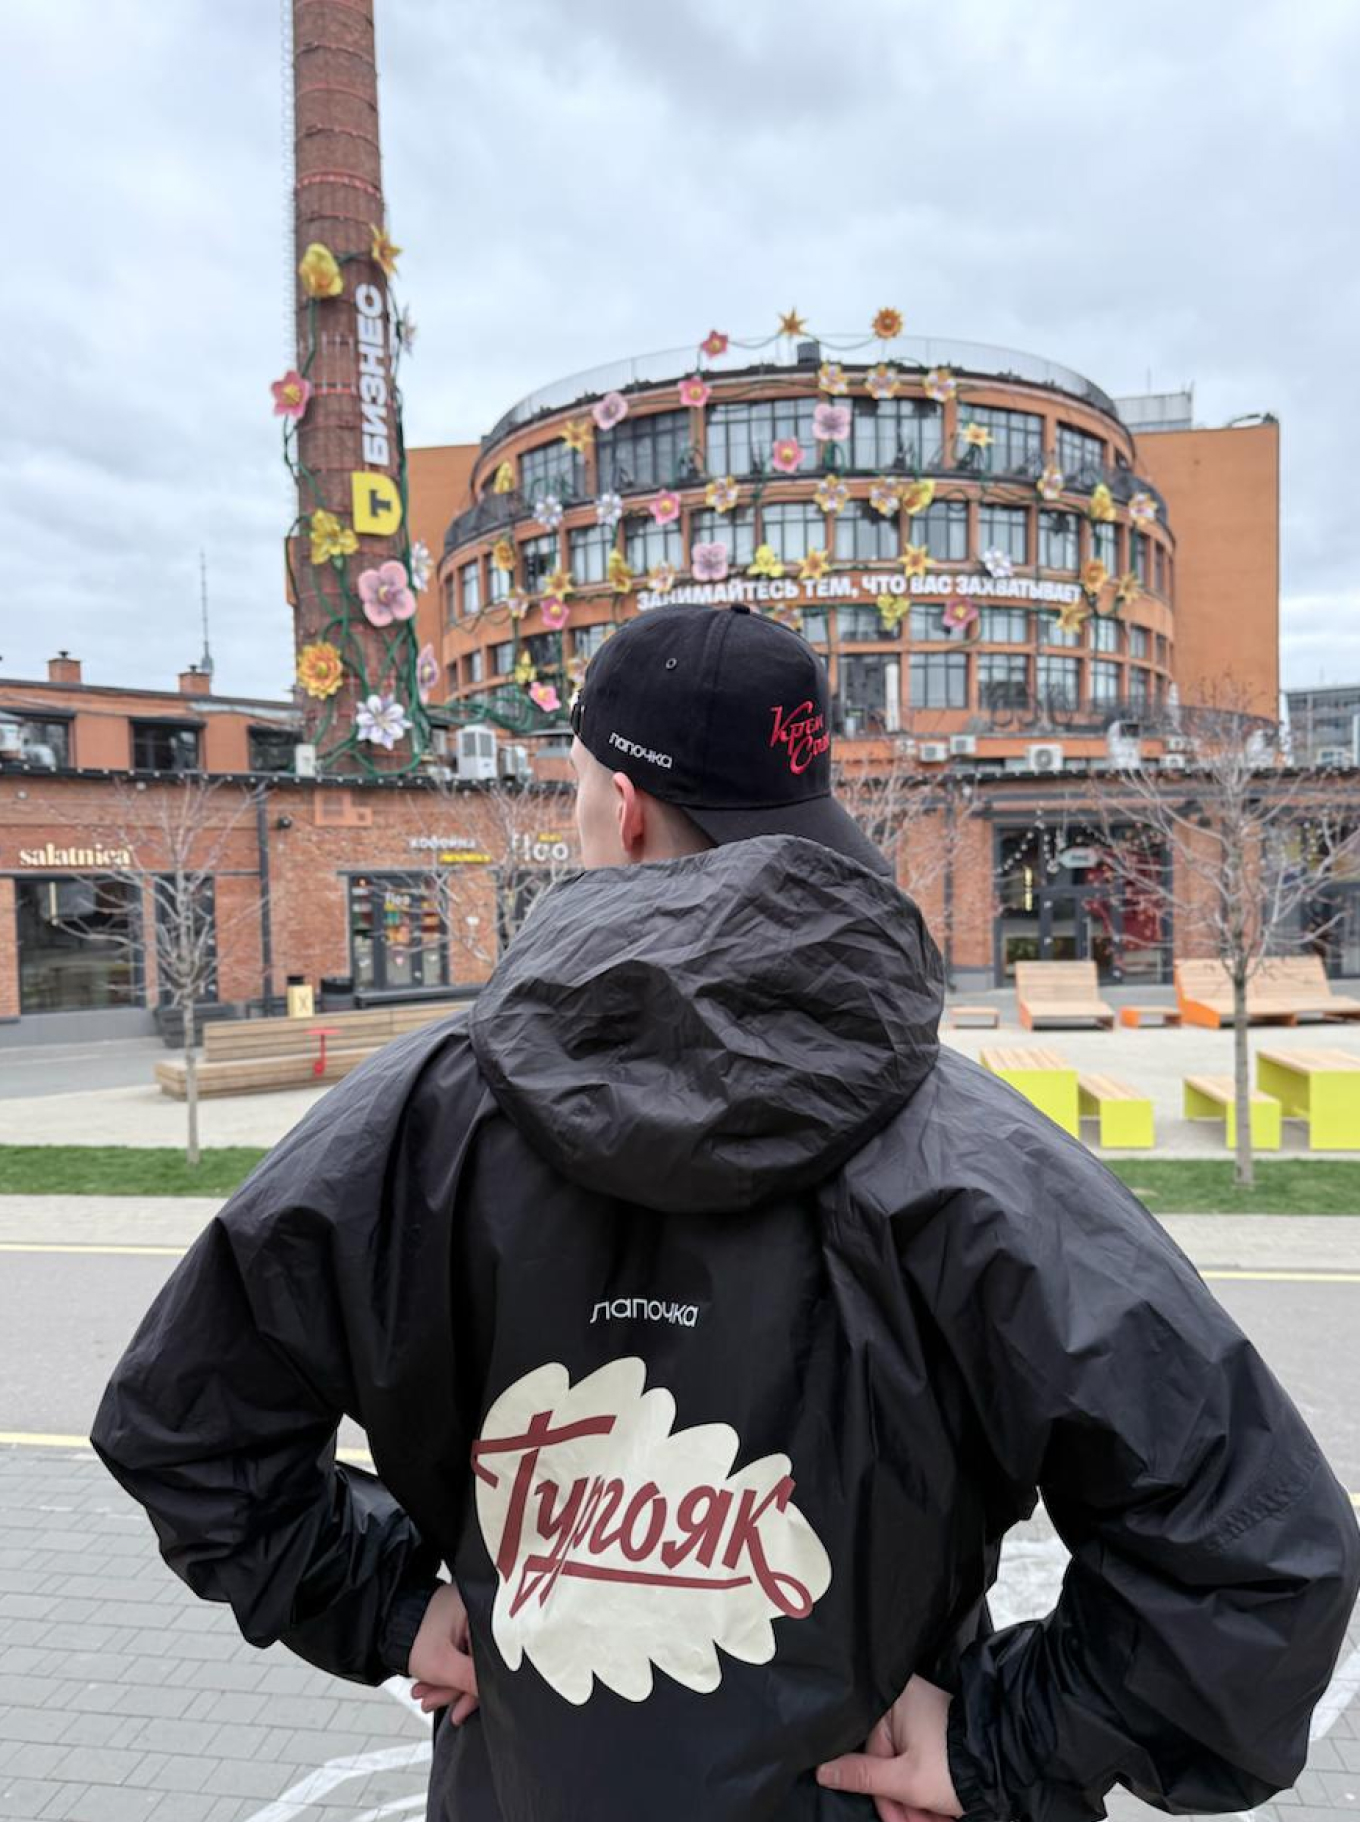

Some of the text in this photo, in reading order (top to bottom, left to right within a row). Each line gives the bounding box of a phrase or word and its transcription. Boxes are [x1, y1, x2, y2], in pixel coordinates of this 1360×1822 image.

[354, 283, 390, 467] БИЗНЕС
[802, 575, 859, 598] ТЕМ,
[861, 574, 907, 594] ЧТО
[911, 574, 951, 594] ВАС
[956, 574, 1082, 603] ЗАХВАТЫВАЕТ
[609, 732, 672, 769] лапочка
[19, 842, 131, 866] salatnica
[589, 1298, 699, 1327] лапочка
